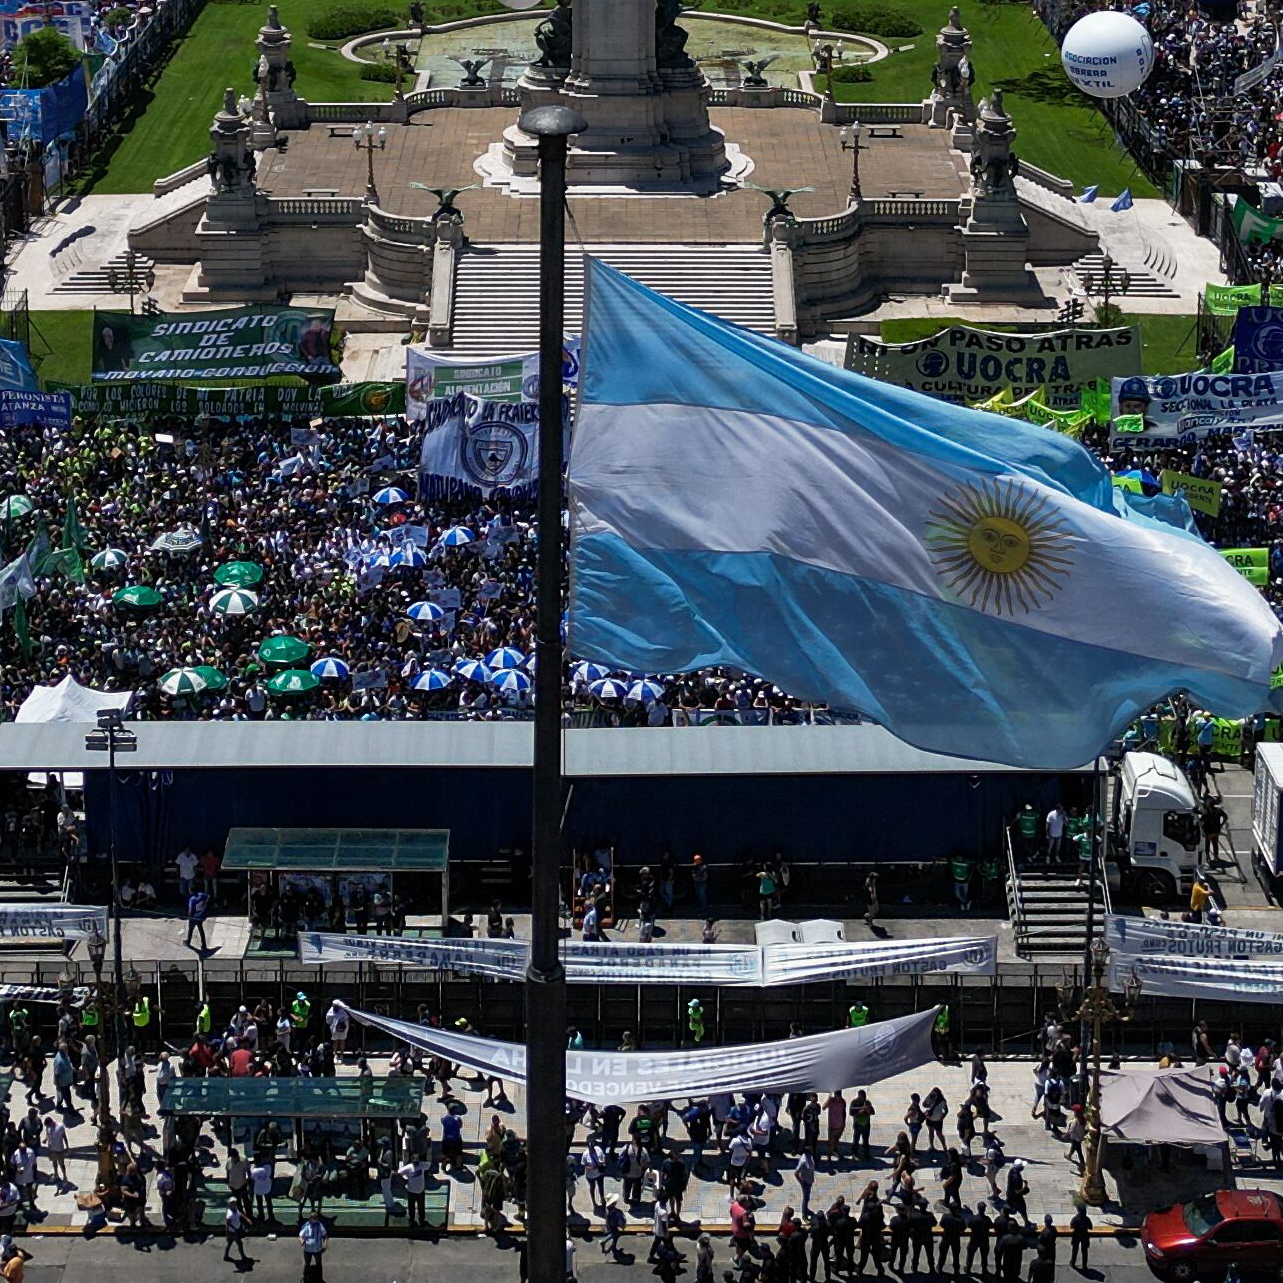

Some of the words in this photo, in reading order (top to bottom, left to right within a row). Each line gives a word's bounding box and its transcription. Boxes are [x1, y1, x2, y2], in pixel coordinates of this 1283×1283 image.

[151, 315, 278, 337] SINDICATO
[199, 333, 234, 347] DE
[950, 330, 1026, 353] PASO
[1038, 330, 1132, 353] ATRAS
[138, 343, 293, 363] CAMIONEROS
[105, 369, 194, 380] MOYANO
[454, 367, 501, 378] SINDICATO
[957, 352, 1070, 383] UOCRA
[224, 388, 265, 402] PATRIA
[922, 380, 1002, 396] CULTURA
[1180, 376, 1276, 398] UOCRA
[1171, 480, 1214, 494] UOCRA
